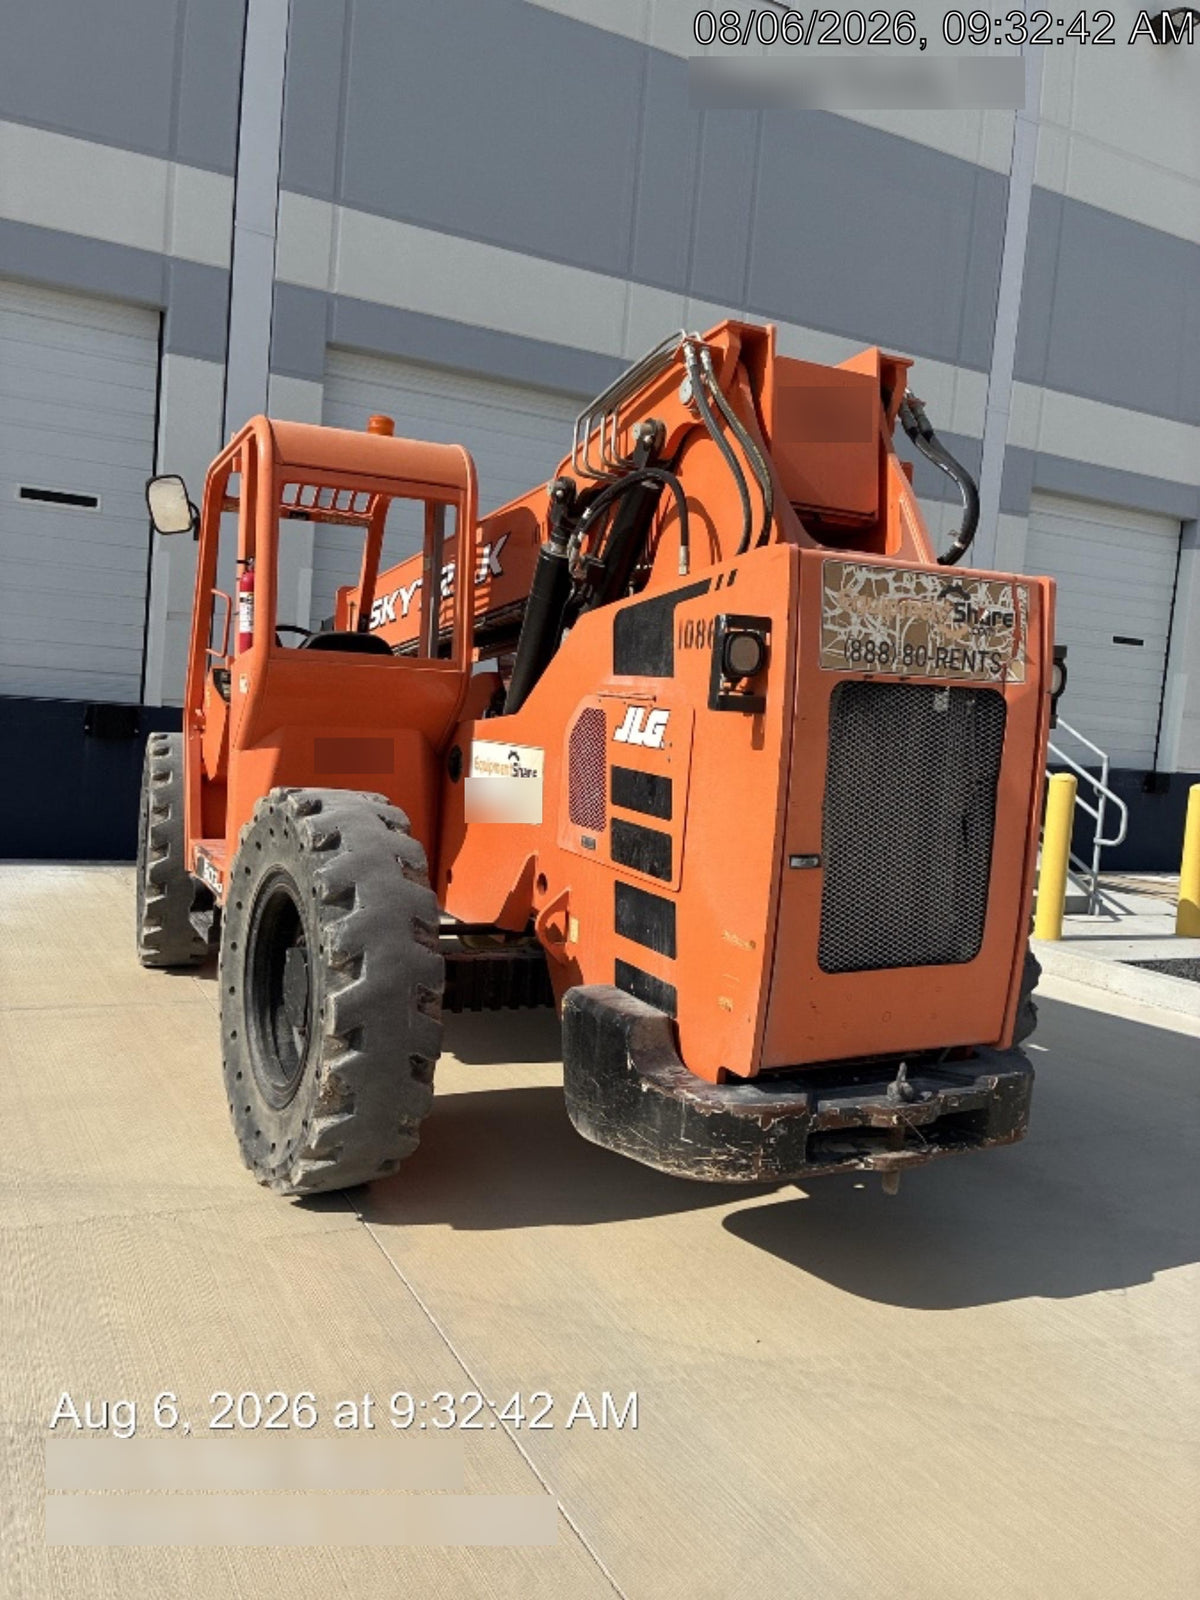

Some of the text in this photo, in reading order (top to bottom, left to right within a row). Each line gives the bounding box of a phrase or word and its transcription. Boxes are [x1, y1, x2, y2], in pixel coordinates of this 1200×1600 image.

[369, 531, 511, 629] SKYK
[844, 639, 895, 666] (888)
[612, 704, 671, 750] JLG
